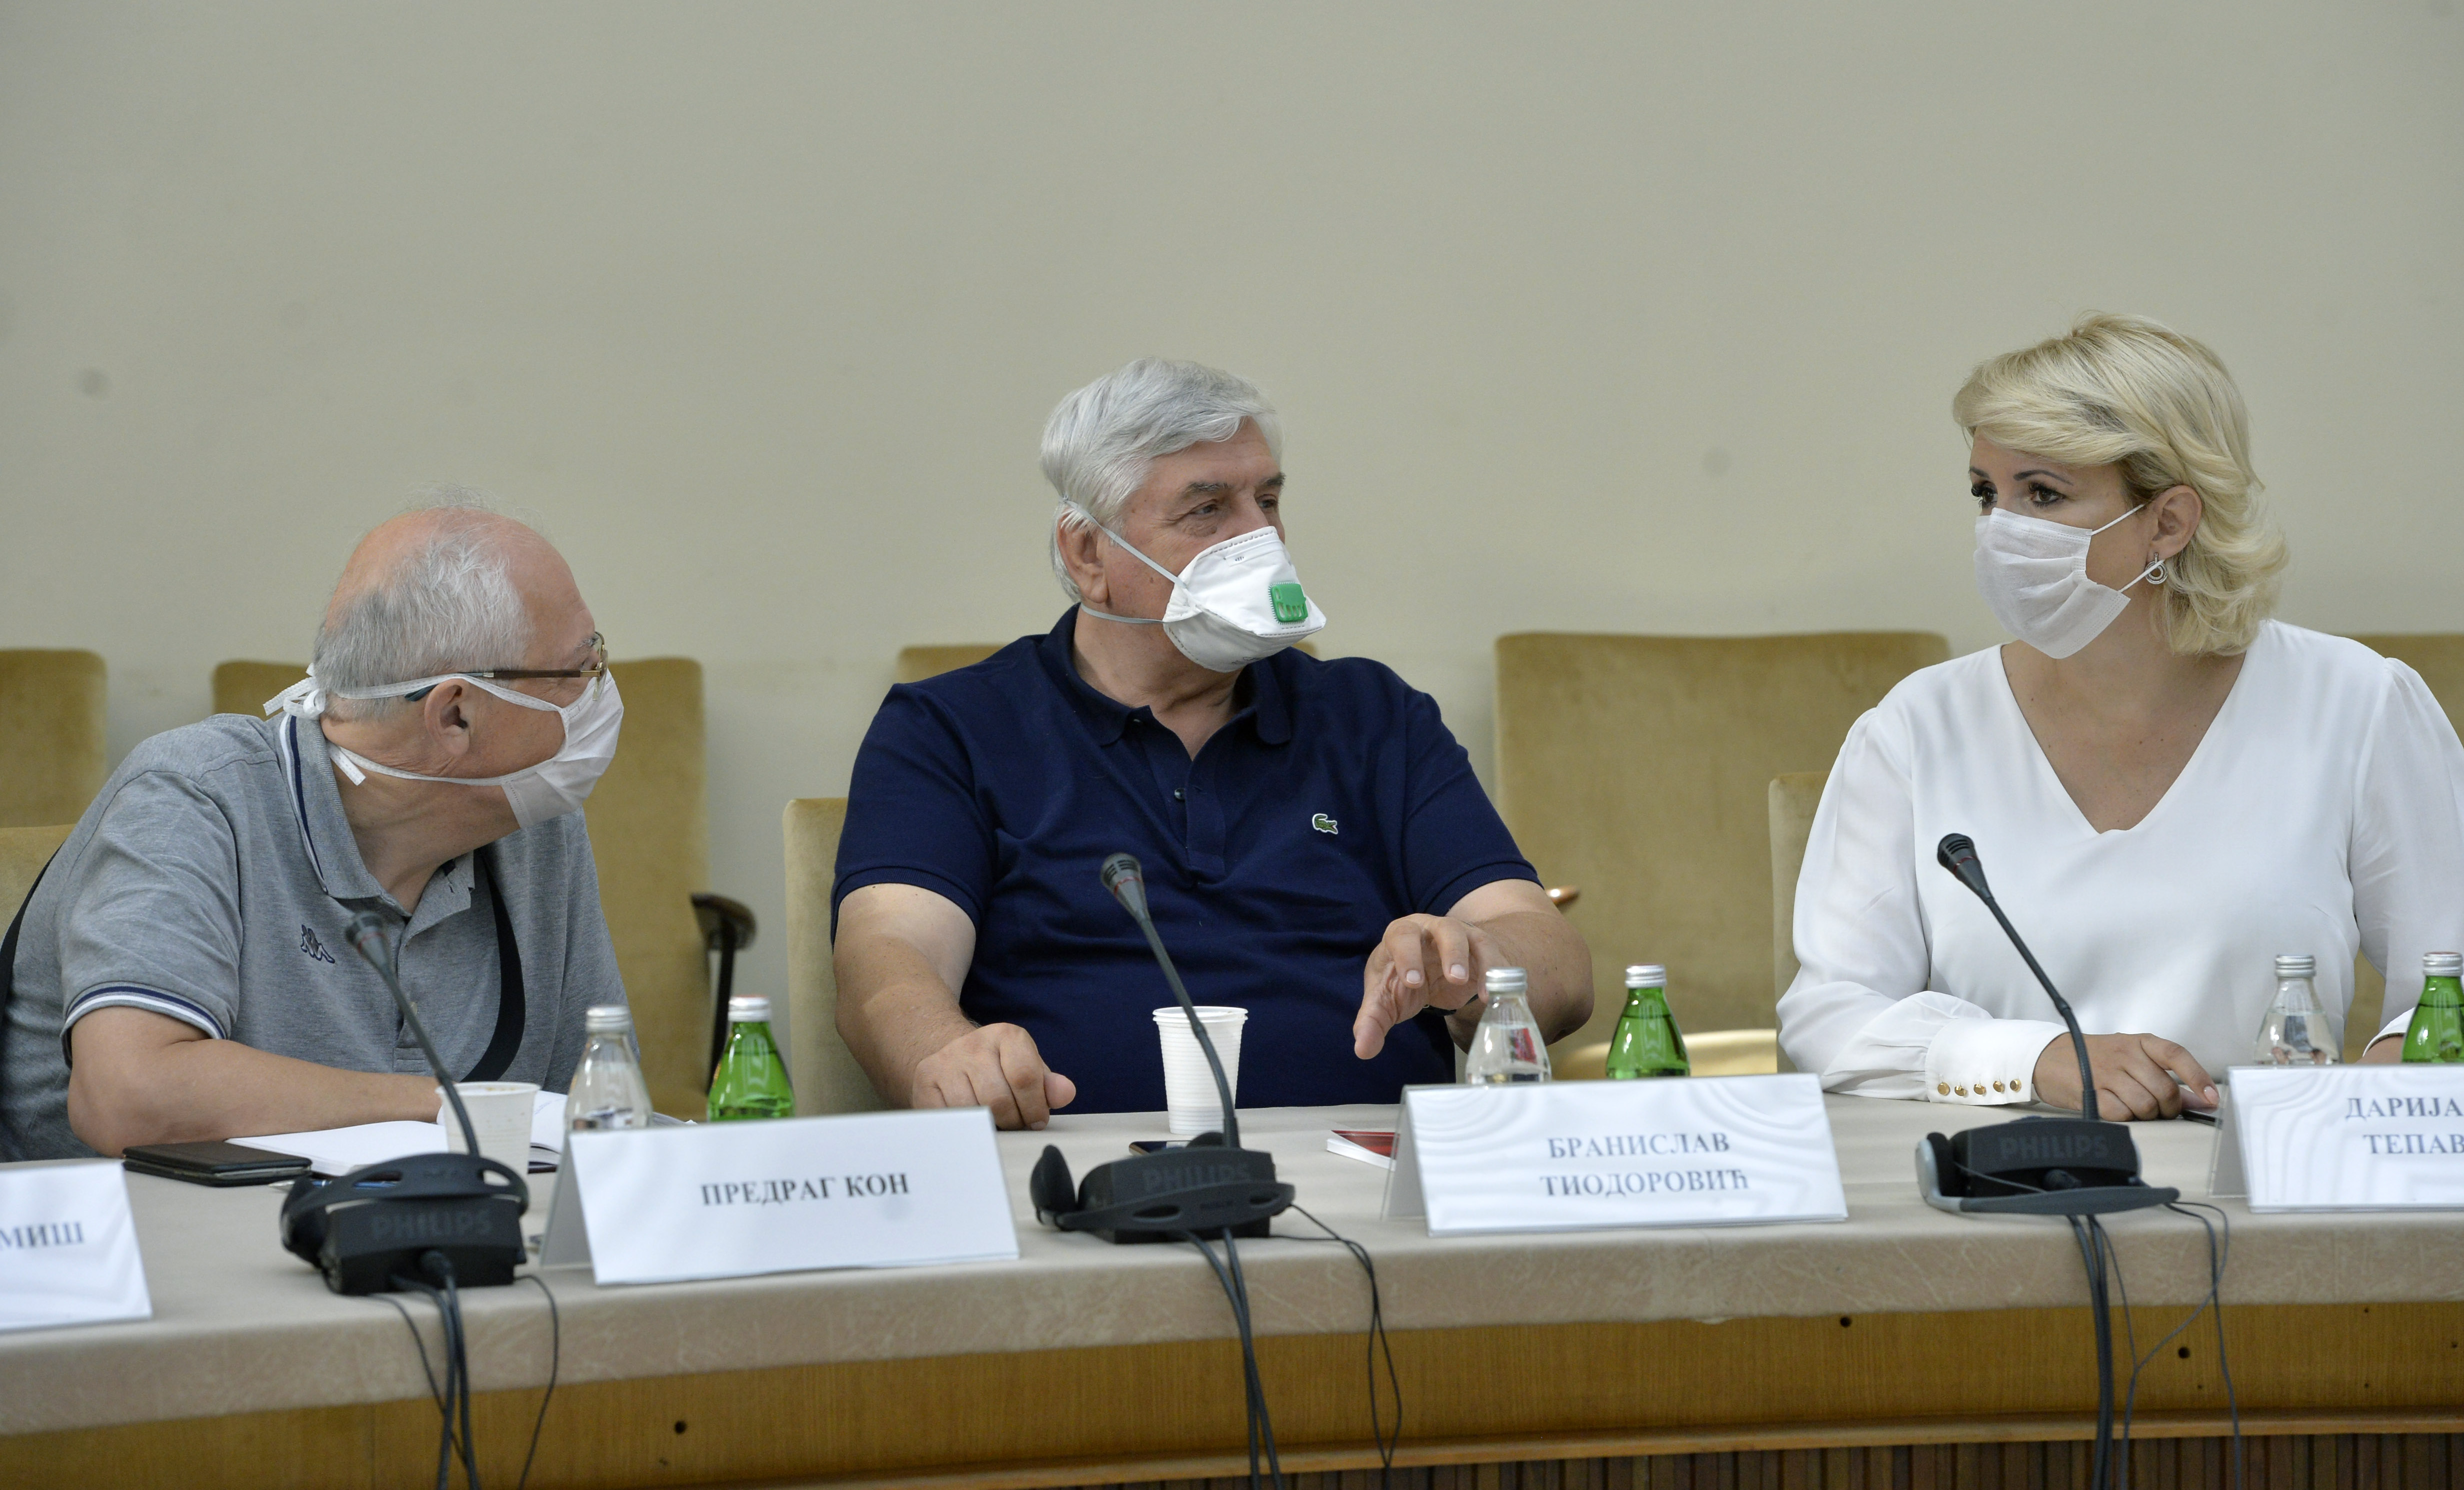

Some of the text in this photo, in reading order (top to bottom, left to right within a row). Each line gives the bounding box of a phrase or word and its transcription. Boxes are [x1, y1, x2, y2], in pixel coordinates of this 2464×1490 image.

[2345, 1097, 2464, 1121] ДАРИЈА
[1548, 1132, 1730, 1159] БРАНИСЛАВ
[1999, 1134, 2110, 1160] PHILIPS
[2362, 1133, 2464, 1154] ТЕПАВ
[701, 1173, 910, 1206] ПРЕДРАГ КОН
[1540, 1169, 1749, 1198] ТИОДОРОВИЋ
[372, 1208, 493, 1241] PHILIPS
